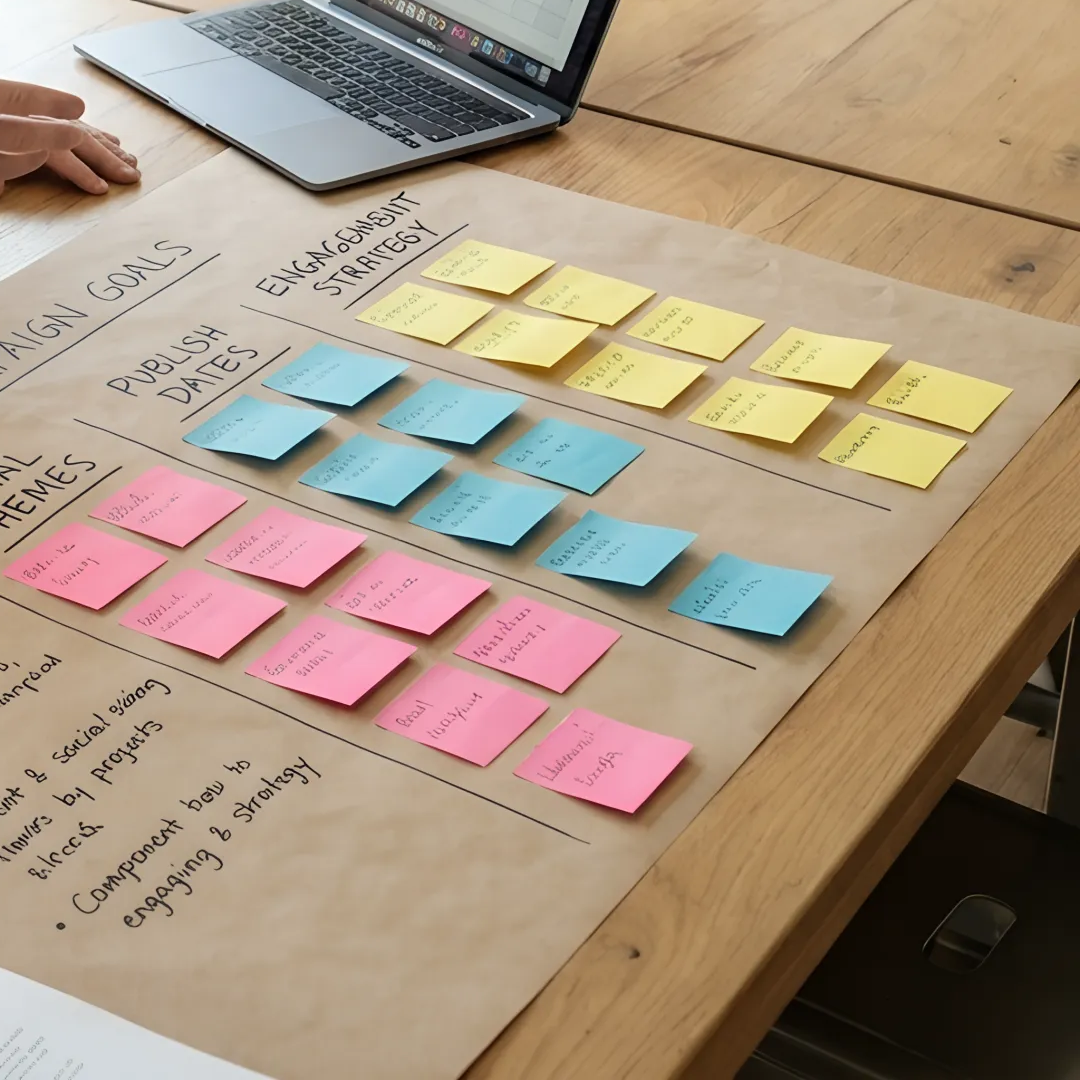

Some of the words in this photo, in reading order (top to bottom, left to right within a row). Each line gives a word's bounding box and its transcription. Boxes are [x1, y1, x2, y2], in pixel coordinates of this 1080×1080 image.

[86, 239, 193, 302] GOALS
[312, 219, 439, 297] STRATEGY
[106, 324, 229, 398] PUBLISH
[156, 347, 259, 405] DATES
